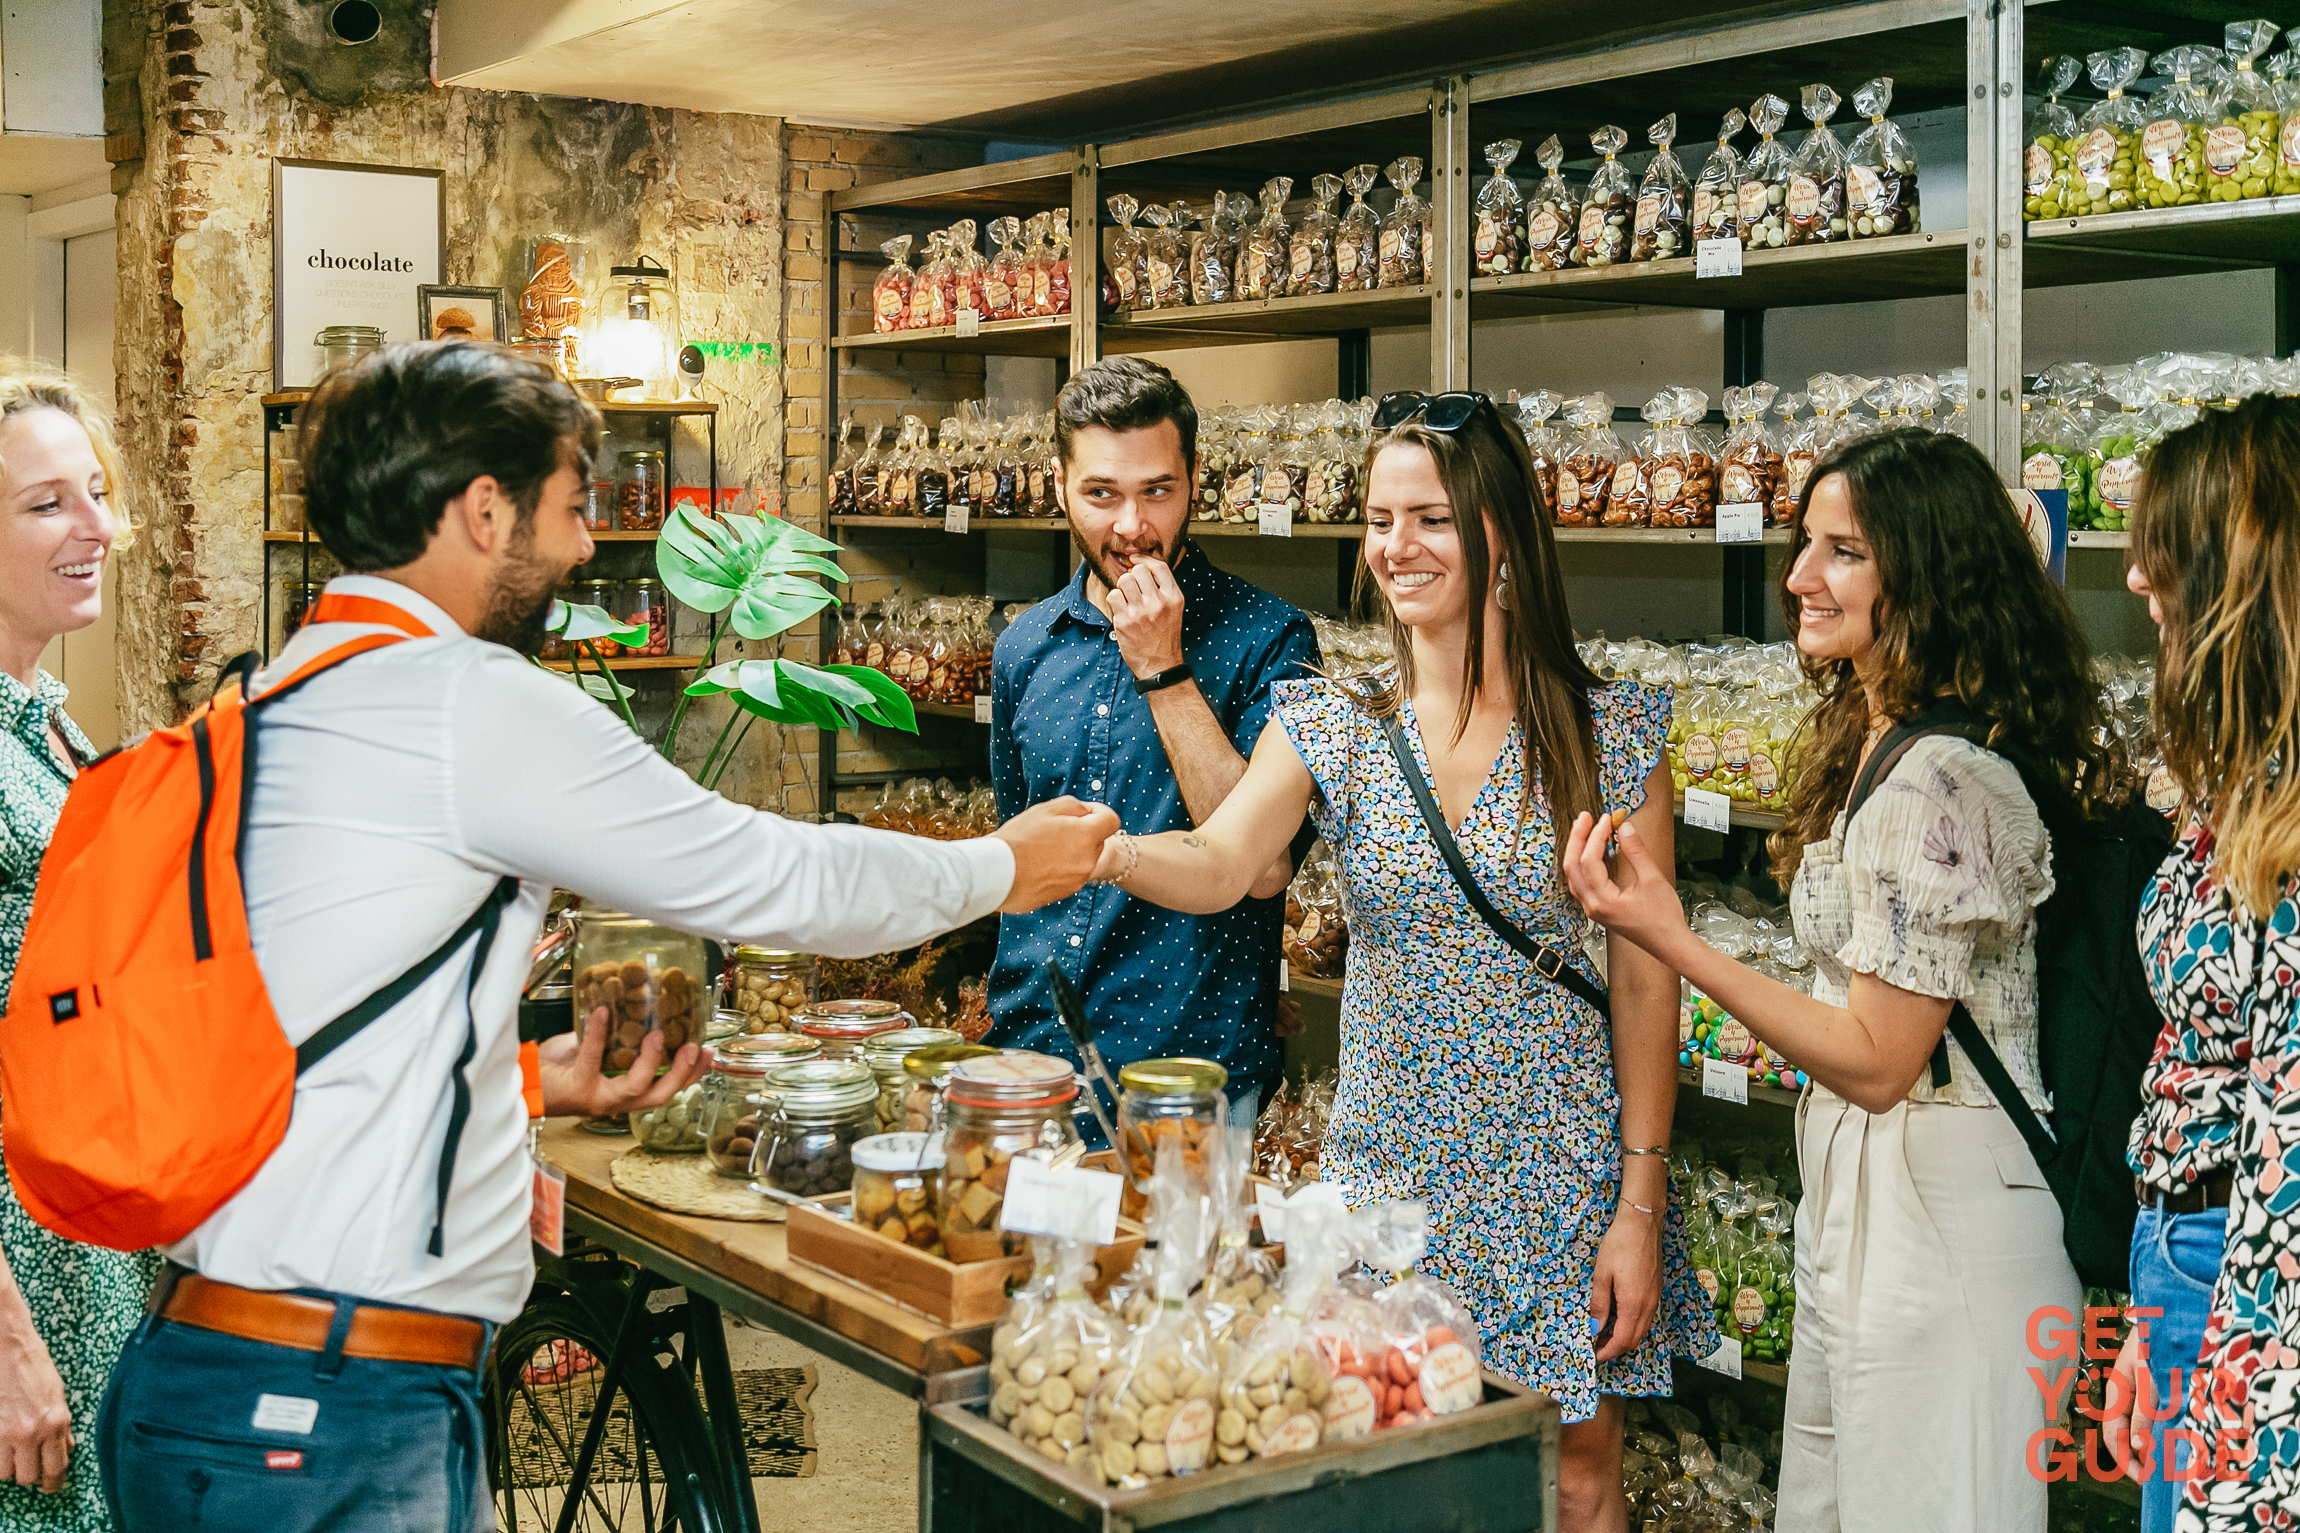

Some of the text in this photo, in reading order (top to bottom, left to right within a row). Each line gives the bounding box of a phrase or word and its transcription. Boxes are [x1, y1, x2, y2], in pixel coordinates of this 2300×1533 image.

[307, 248, 414, 273] chocolate
[360, 281, 375, 289] ASK
[377, 282, 398, 290] SILLY
[314, 289, 408, 301] QUESTIONS CHOCOLATE
[332, 300, 390, 310] UNDERSTANDS
